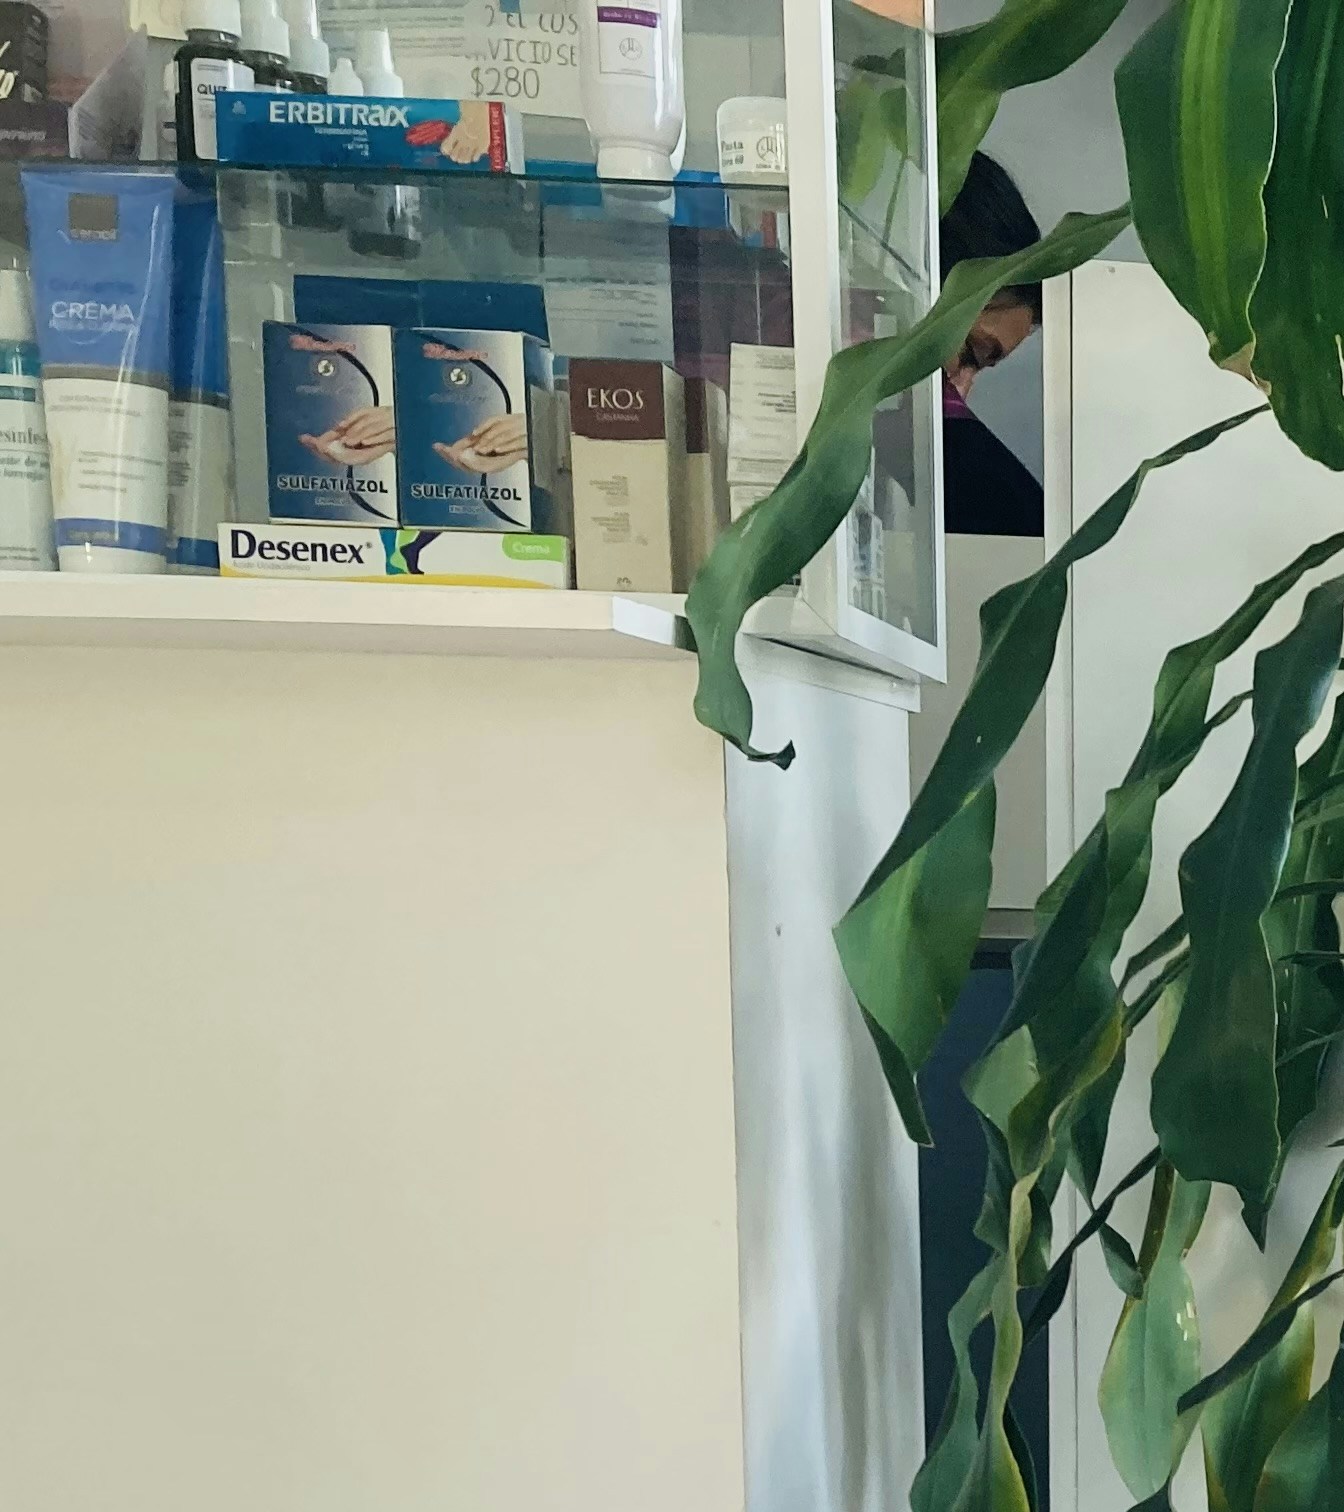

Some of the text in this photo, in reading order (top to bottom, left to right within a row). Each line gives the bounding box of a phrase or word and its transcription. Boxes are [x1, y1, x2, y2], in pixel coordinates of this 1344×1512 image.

[471, 66, 540, 99] $280
[588, 388, 643, 409] EKOS
[277, 475, 388, 494] SULFATIAZOL
[411, 483, 522, 501] SULFATIAZOL
